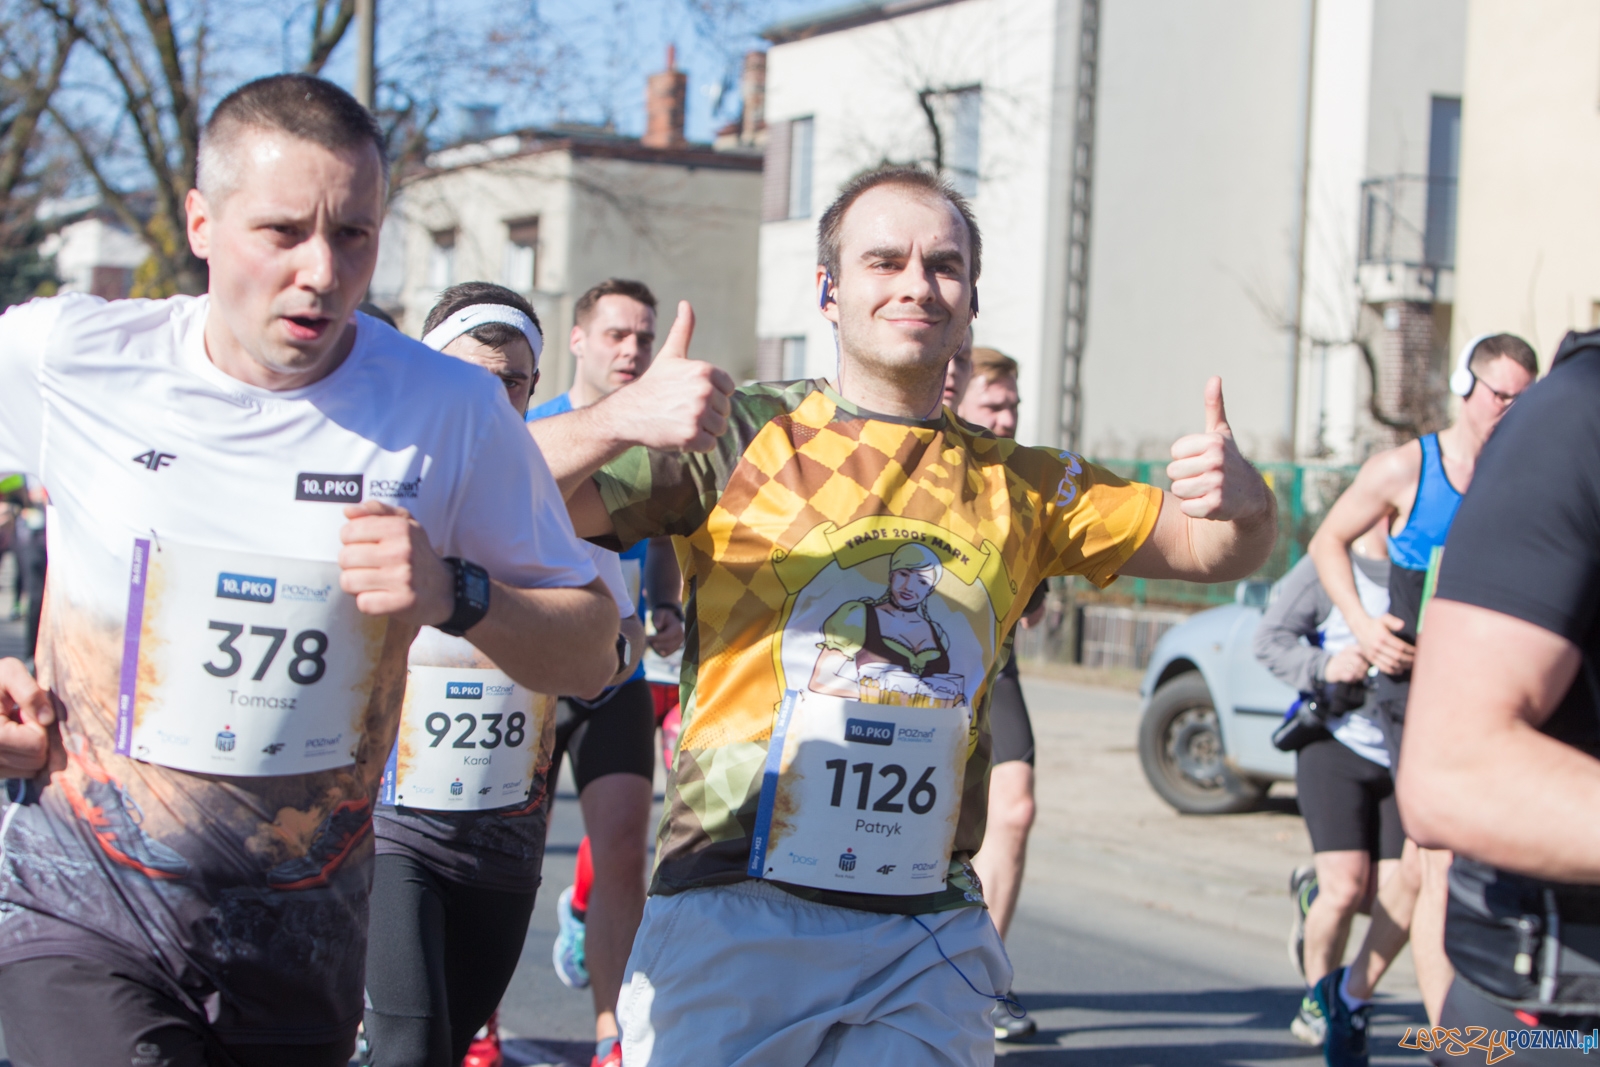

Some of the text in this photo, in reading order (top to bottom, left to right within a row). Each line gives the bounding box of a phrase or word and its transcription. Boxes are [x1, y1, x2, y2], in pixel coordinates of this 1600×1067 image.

[132, 450, 177, 471] 4F
[302, 479, 359, 497] 10. PKO
[845, 528, 971, 566] TRADE 2005 MARK
[222, 578, 273, 598] 10. PKO
[202, 620, 329, 686] 378
[228, 689, 298, 710] Tomasz
[449, 686, 480, 696] 10. PKO
[425, 711, 526, 750] 9238
[850, 725, 891, 739] 10. PKO
[463, 755, 492, 766] Karol
[825, 758, 937, 815] 1126
[855, 819, 902, 837] Patryk
[876, 864, 897, 875] 4F
